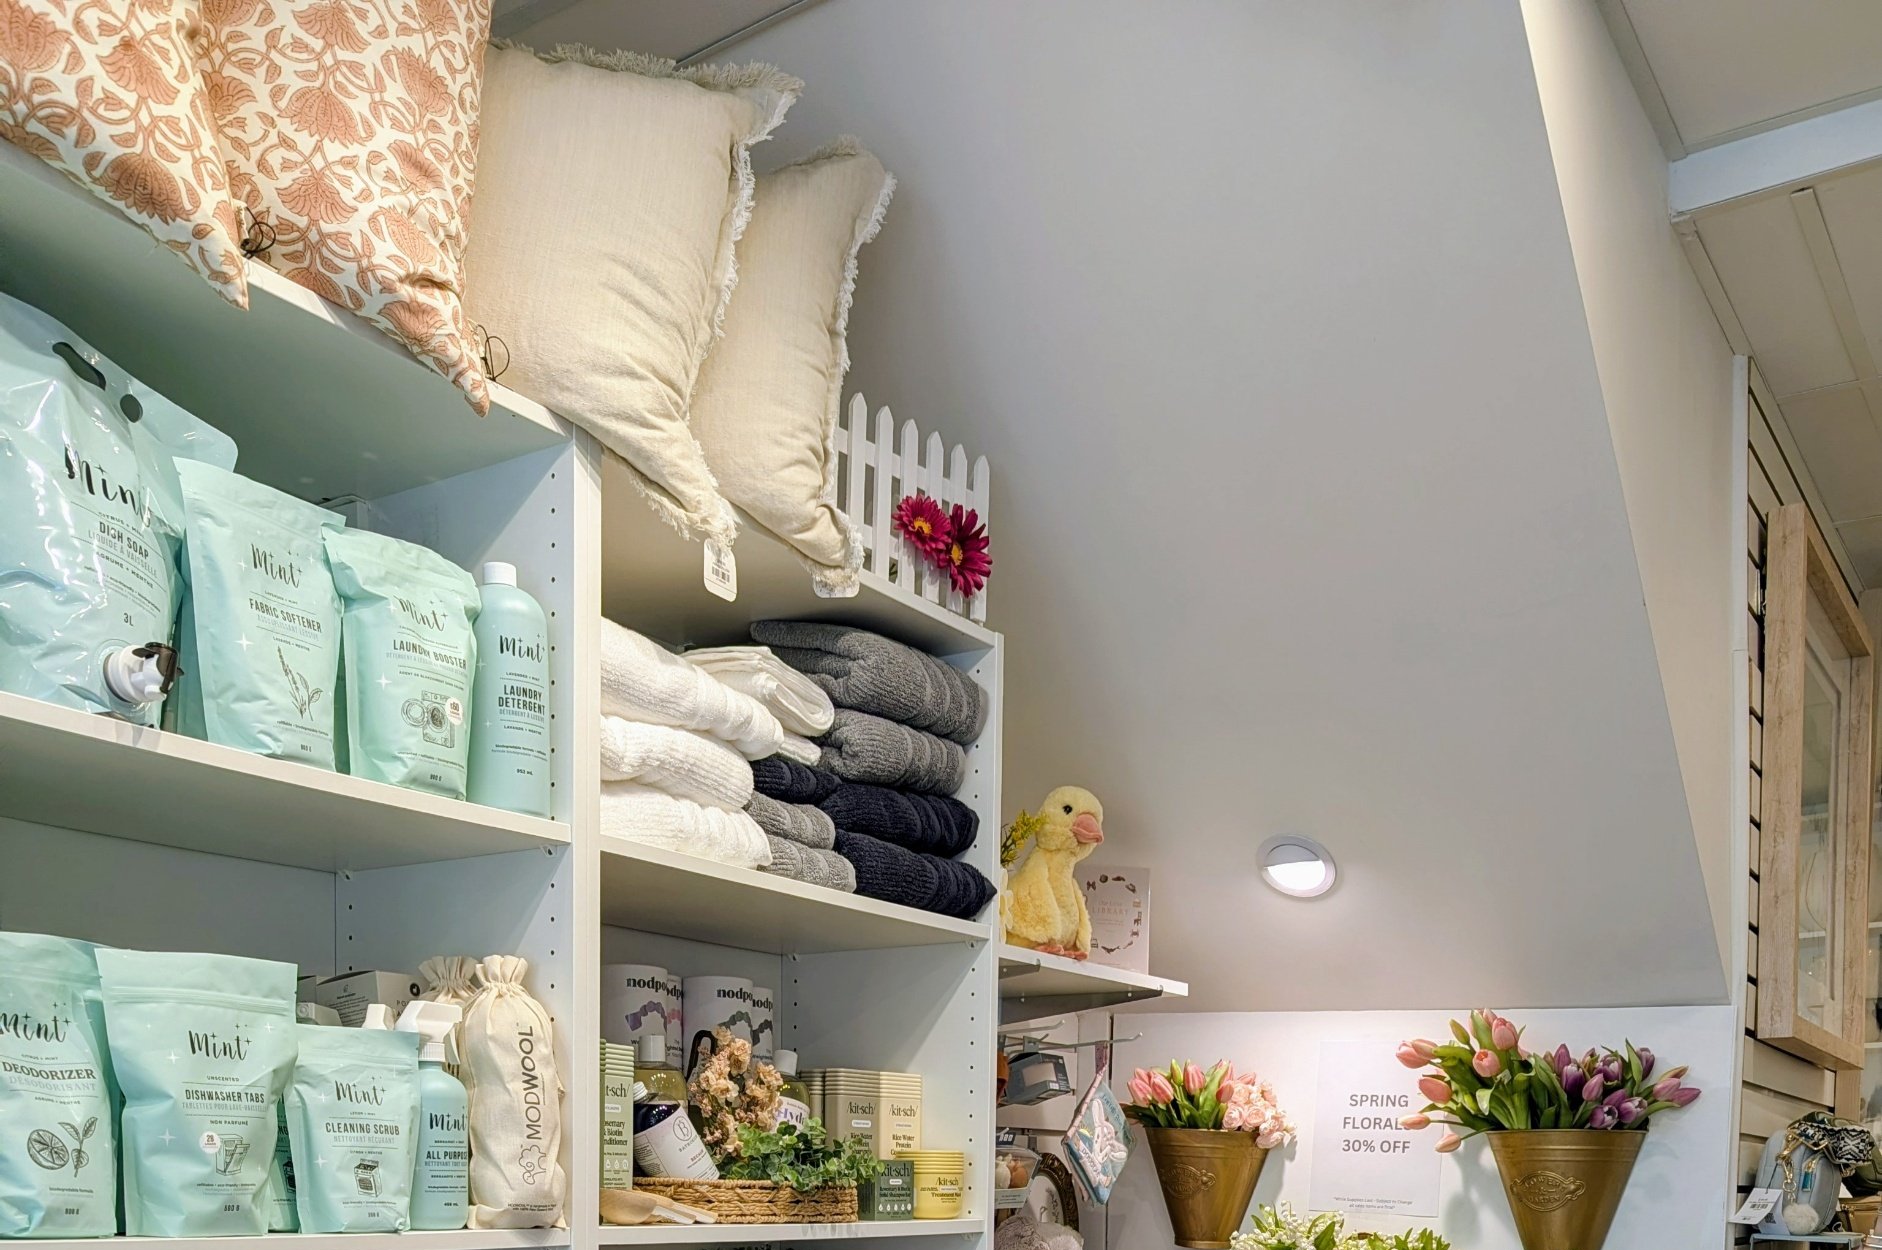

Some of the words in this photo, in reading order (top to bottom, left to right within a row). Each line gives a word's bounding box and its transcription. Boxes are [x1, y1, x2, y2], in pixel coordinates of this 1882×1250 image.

[99, 521, 124, 544] DISH
[126, 537, 149, 560] SOAP
[251, 543, 300, 588] Mint
[123, 612, 134, 627] 3L
[249, 598, 279, 619] FABRIC
[280, 609, 322, 633] SOFTENER
[393, 595, 445, 631] Mint
[499, 634, 543, 664] Mint
[433, 651, 467, 670] BOOSTER
[503, 684, 542, 702] LAUNDRY
[498, 696, 546, 716] DETERGENT
[626, 976, 667, 993] nodpo
[716, 988, 753, 1003] nodpo
[0, 1012, 66, 1042] Mint
[188, 1030, 247, 1060] Mint
[2, 1061, 96, 1080] DEODORIZER
[517, 1025, 542, 1141] MODWOOL
[185, 1089, 242, 1102] DISHWASHER
[244, 1092, 265, 1104] TABS
[335, 1080, 383, 1106] Mint
[1349, 1093, 1409, 1108] SPRING
[325, 1122, 371, 1134] CLEANING
[374, 1124, 400, 1136] SCRUB
[429, 1112, 467, 1131] Mint
[1342, 1116, 1409, 1131] FLORAL
[333, 1135, 366, 1143] NETTOYANT
[1342, 1139, 1376, 1153] 30%
[1380, 1140, 1411, 1154] OFF
[426, 1151, 441, 1160] ALL
[443, 1151, 468, 1160] PURPOS
